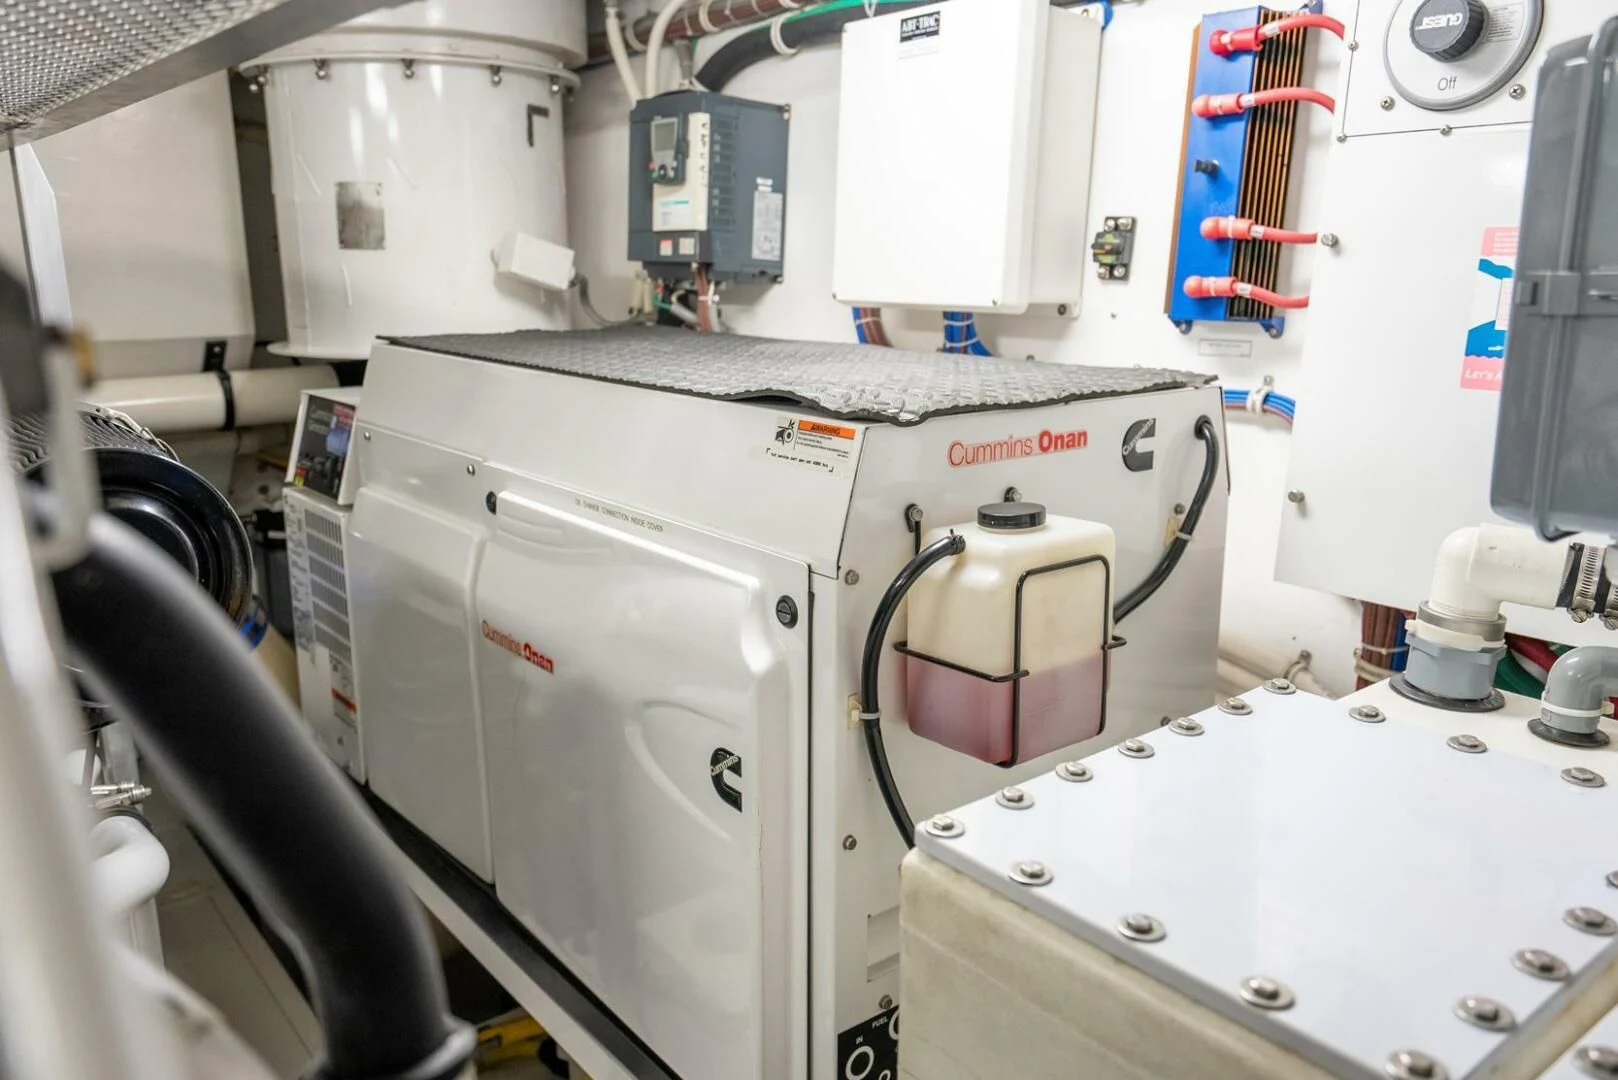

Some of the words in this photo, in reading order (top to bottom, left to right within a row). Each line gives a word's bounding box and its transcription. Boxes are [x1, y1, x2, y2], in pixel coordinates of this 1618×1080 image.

[1415, 13, 1463, 30] GUEST
[1438, 76, 1457, 91] Off
[815, 424, 841, 436] WARNING
[949, 436, 1033, 466] Cummins
[1038, 430, 1087, 453] Onan
[482, 620, 522, 656] Cummins
[523, 643, 554, 674] Onan
[710, 755, 739, 776] Cummins
[872, 1016, 888, 1029] FUEL
[855, 1035, 863, 1045] IN
